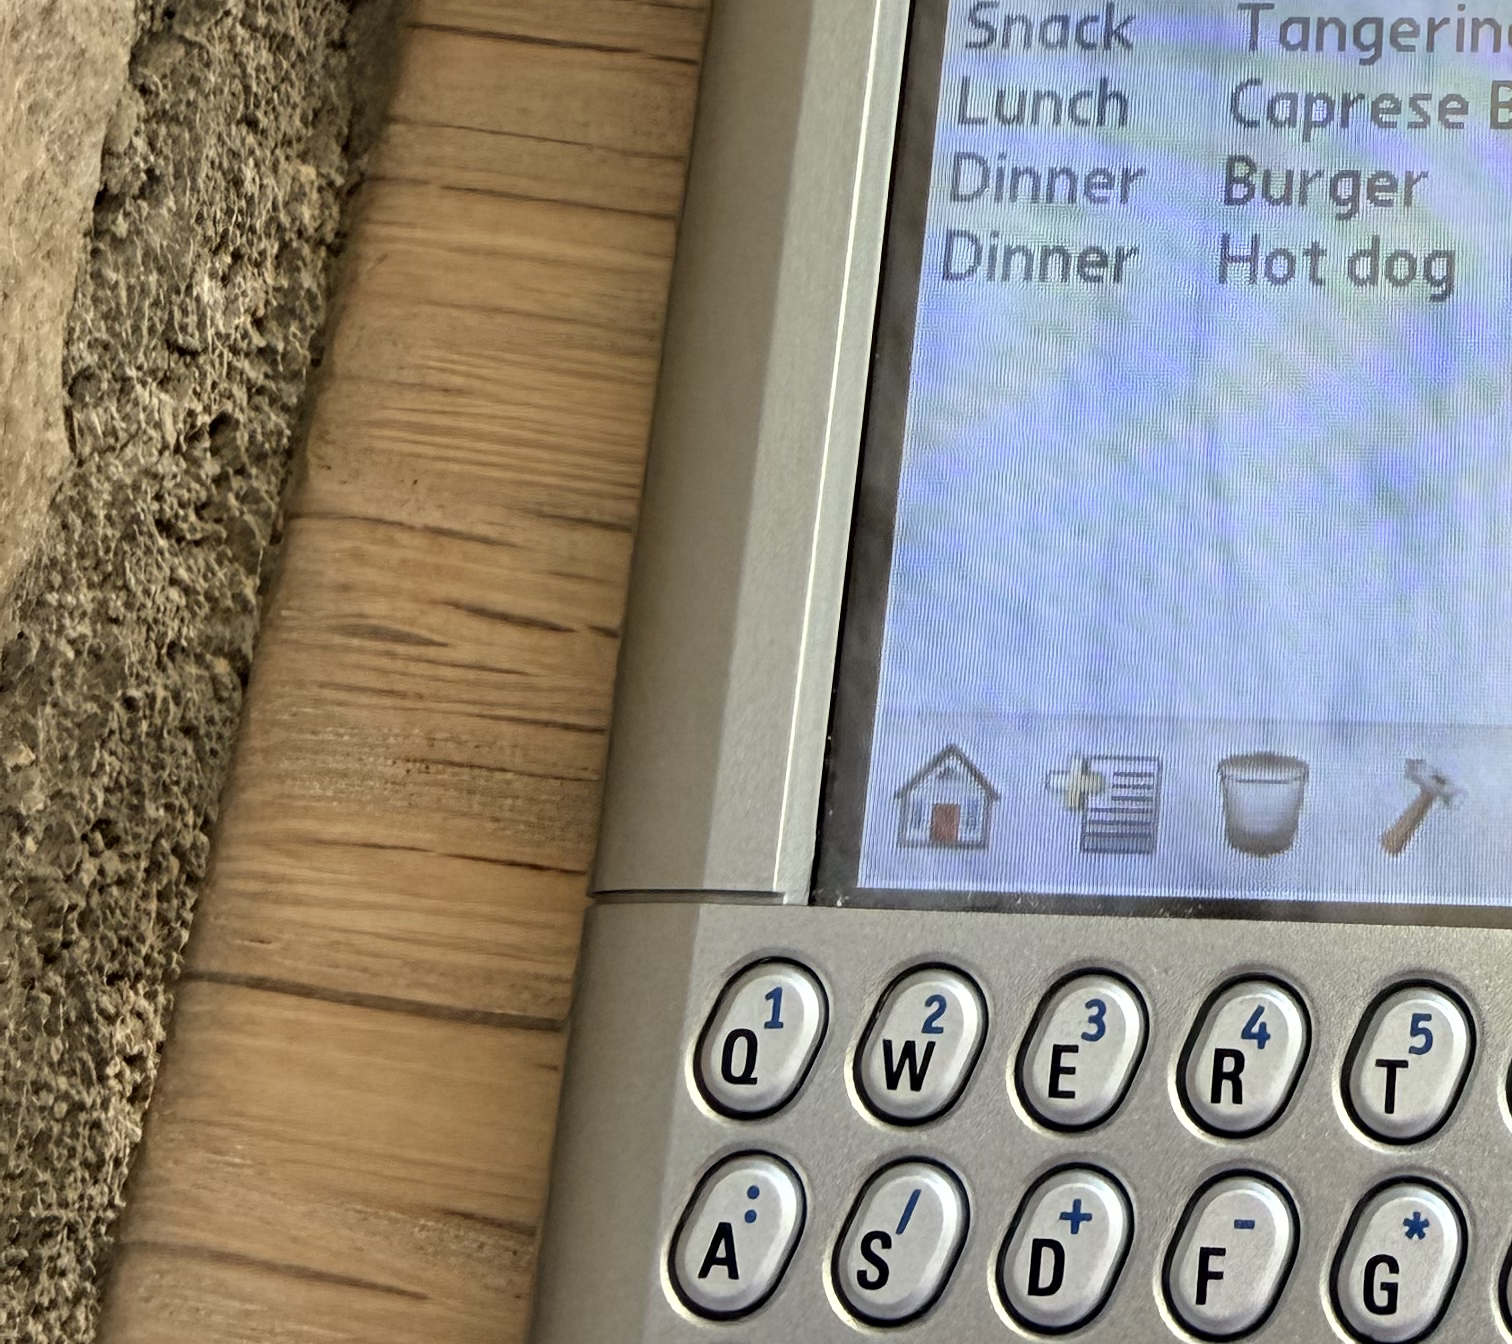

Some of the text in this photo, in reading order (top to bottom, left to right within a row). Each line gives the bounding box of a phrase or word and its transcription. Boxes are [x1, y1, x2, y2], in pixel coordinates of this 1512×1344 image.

[965, 1, 1135, 50] Snack
[956, 76, 1129, 128] Lunch
[1230, 78, 1469, 142] Caprese
[949, 152, 1146, 203] Dinner
[1223, 154, 1428, 220] Burger
[941, 229, 1140, 283] Dinner
[1218, 233, 1326, 286] Hot
[1347, 236, 1456, 302] dog
[767, 988, 782, 1028] 1
[923, 995, 946, 1033] 2
[1082, 1000, 1106, 1041] 3
[1242, 1008, 1270, 1048] 4
[1411, 1014, 1432, 1054] 5
[721, 1029, 757, 1085] Q
[883, 1039, 935, 1091] W
[1048, 1044, 1078, 1098] E
[1211, 1048, 1244, 1104] R
[1376, 1059, 1408, 1114] T
[698, 1222, 739, 1280] A
[857, 1231, 891, 1290] S
[1028, 1239, 1065, 1296] D
[1196, 1247, 1226, 1305] F
[1364, 1254, 1399, 1315] G
